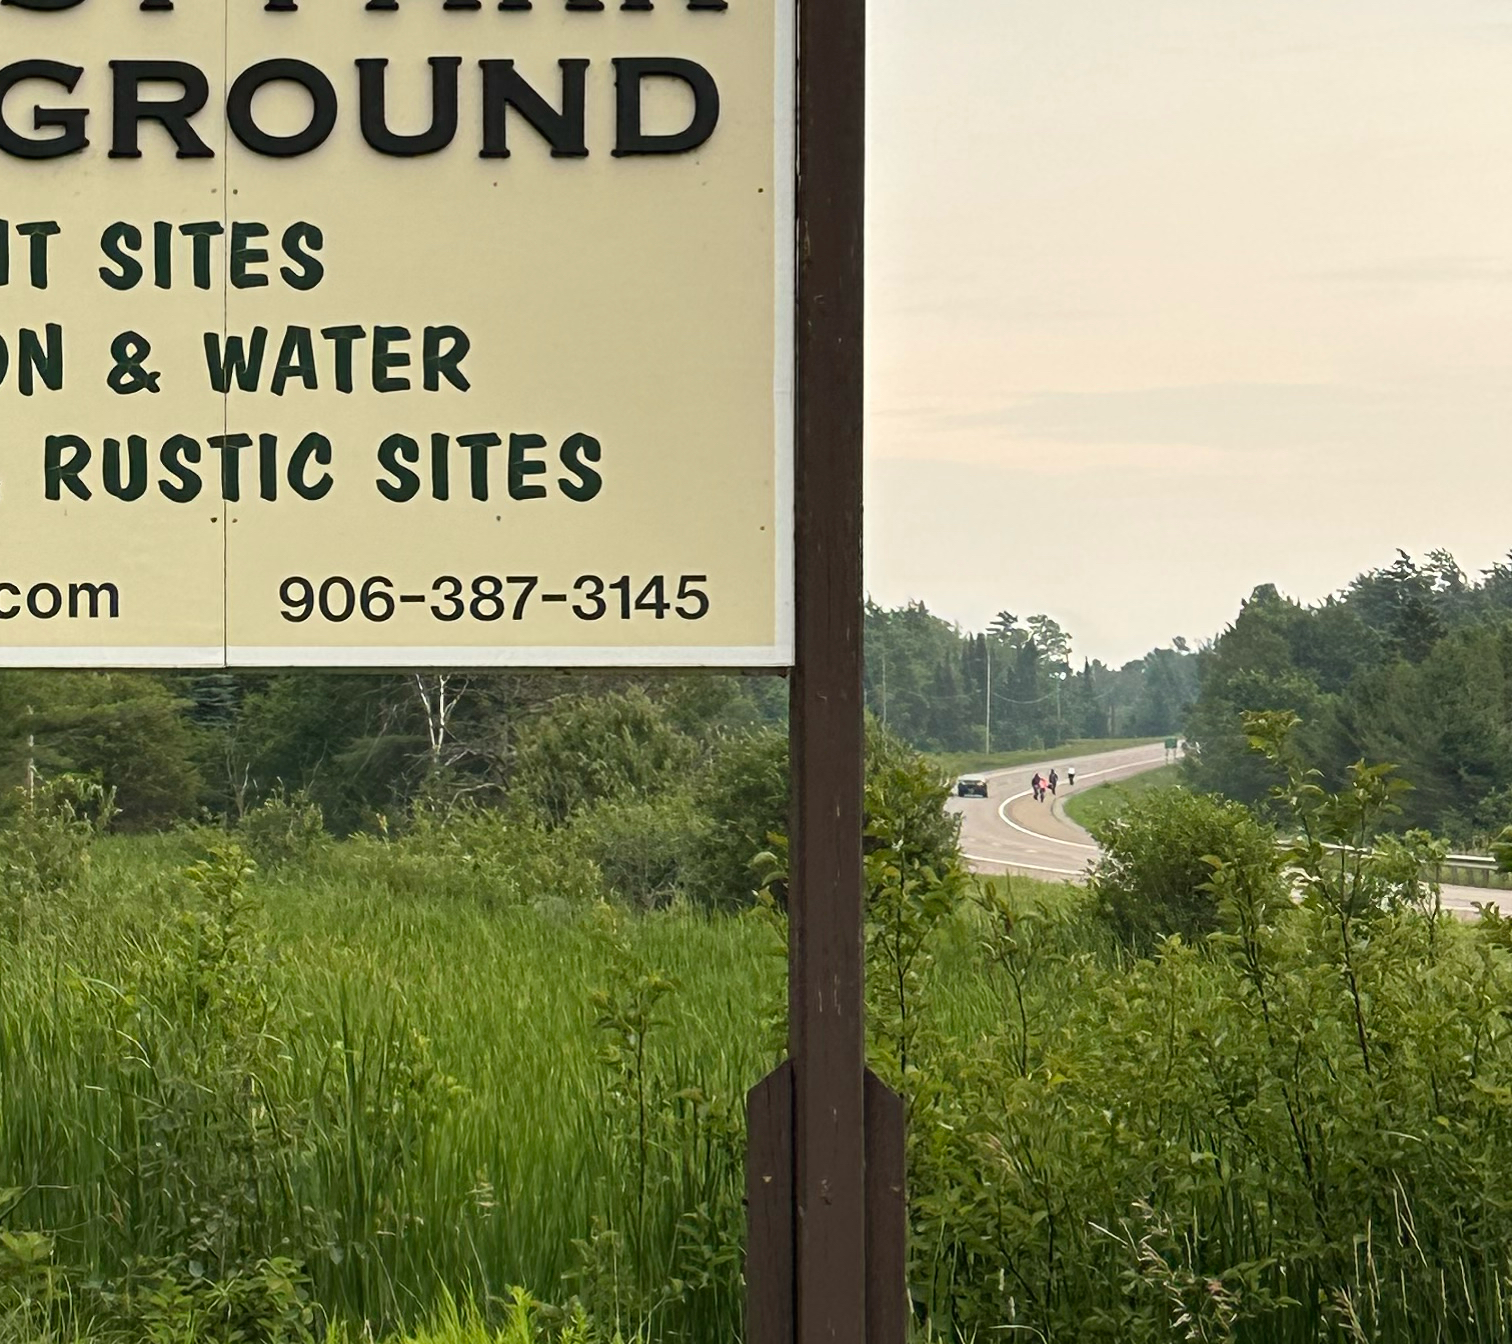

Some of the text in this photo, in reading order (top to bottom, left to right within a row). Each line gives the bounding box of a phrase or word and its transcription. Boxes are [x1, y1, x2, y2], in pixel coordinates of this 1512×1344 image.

[98, 220, 325, 291] SITES
[106, 330, 161, 395] &
[203, 324, 471, 396] WATER
[44, 431, 334, 504] RUSTIC
[375, 432, 603, 503] SITES
[278, 574, 711, 623] 906-387-3145
